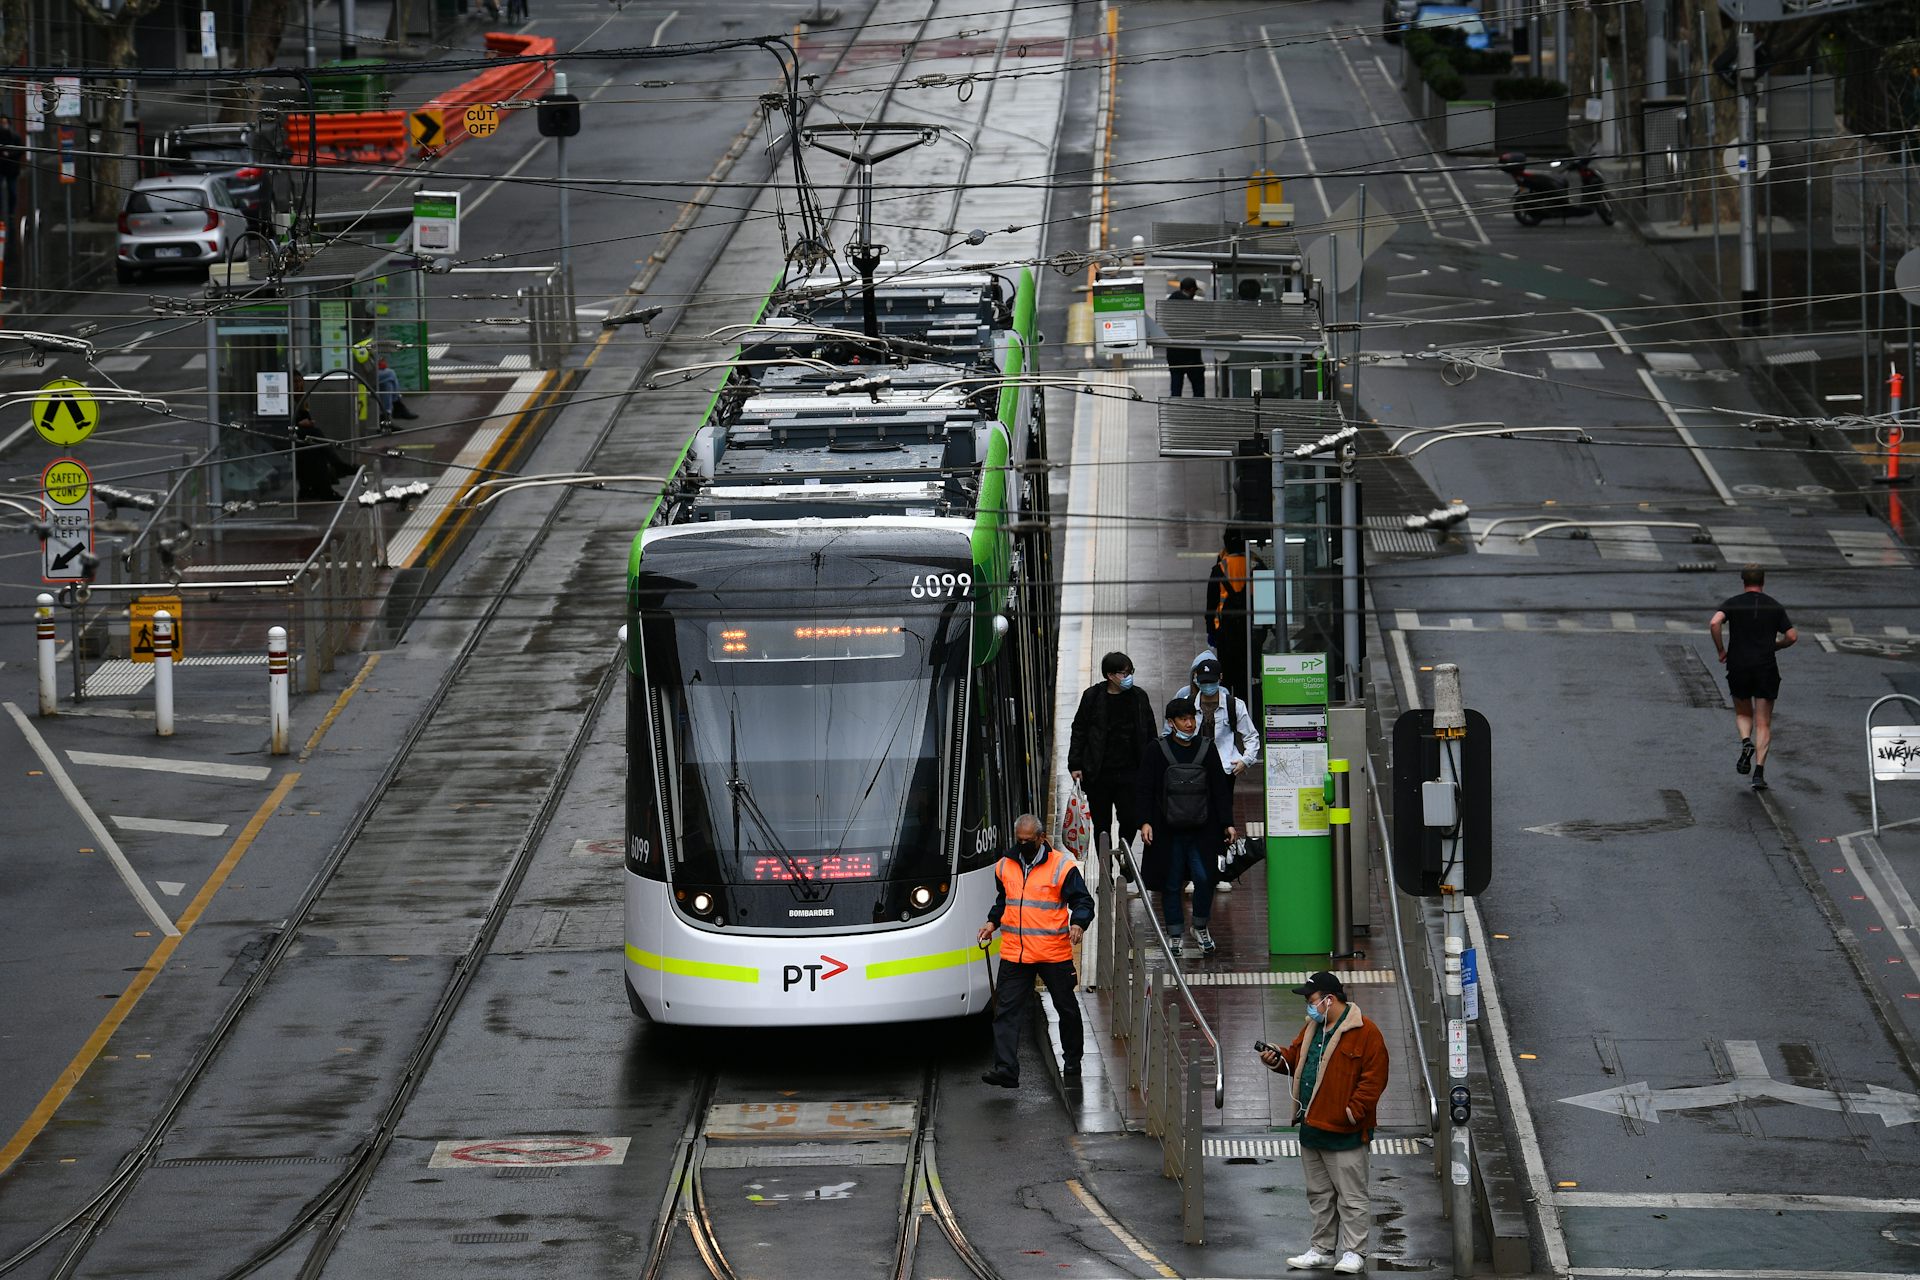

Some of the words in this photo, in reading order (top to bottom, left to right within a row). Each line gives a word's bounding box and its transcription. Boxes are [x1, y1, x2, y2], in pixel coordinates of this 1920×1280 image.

[467, 110, 494, 120] CUT
[469, 124, 495, 134] OFF
[51, 473, 81, 484] SAFETY
[56, 486, 77, 497] ZONE
[55, 529, 80, 539] LEFT
[911, 573, 971, 598] 6099
[976, 825, 997, 854] 6099
[631, 834, 649, 863] 6099
[789, 909, 834, 917] BOMBARDIER
